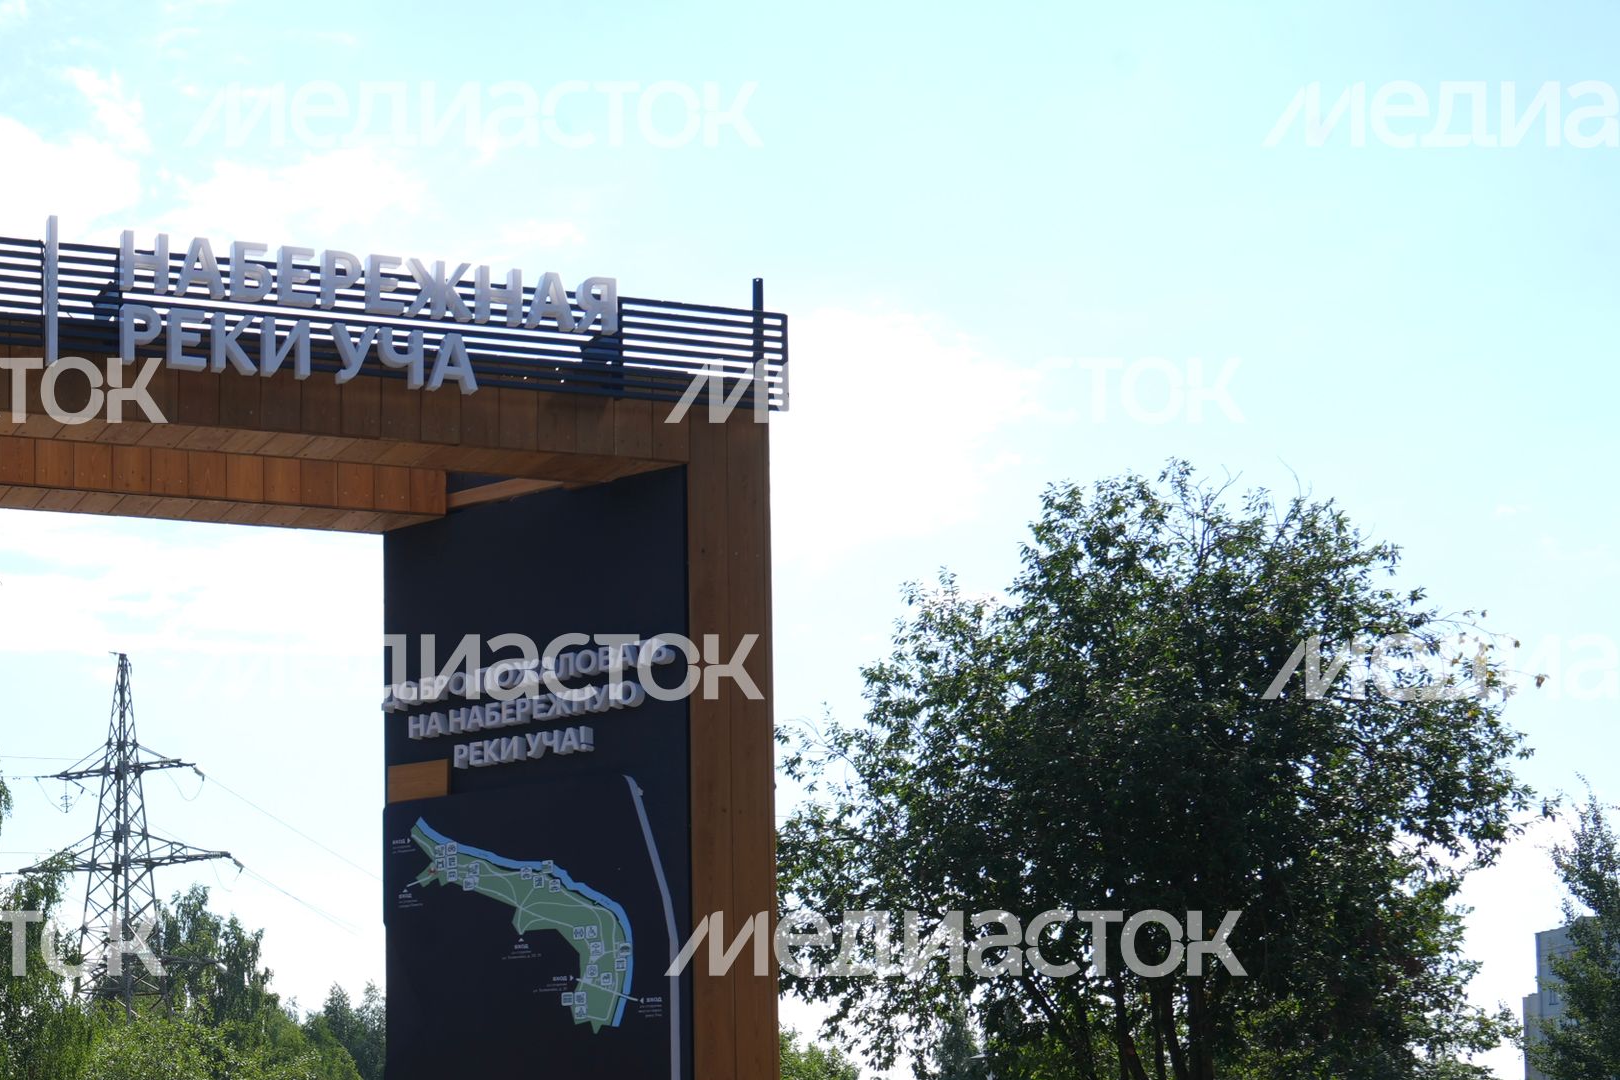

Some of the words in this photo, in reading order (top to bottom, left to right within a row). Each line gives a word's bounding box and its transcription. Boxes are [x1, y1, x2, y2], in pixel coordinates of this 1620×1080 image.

[120, 230, 618, 335] НАБЕРЕЖНАЯ
[119, 304, 310, 380] РЕКИ
[330, 322, 478, 395] УЧА
[408, 711, 452, 740] НА
[449, 680, 646, 735] НАБЕРЕЖНУЮ
[453, 734, 528, 769] РЕКИ
[525, 725, 595, 758] УЧА!
